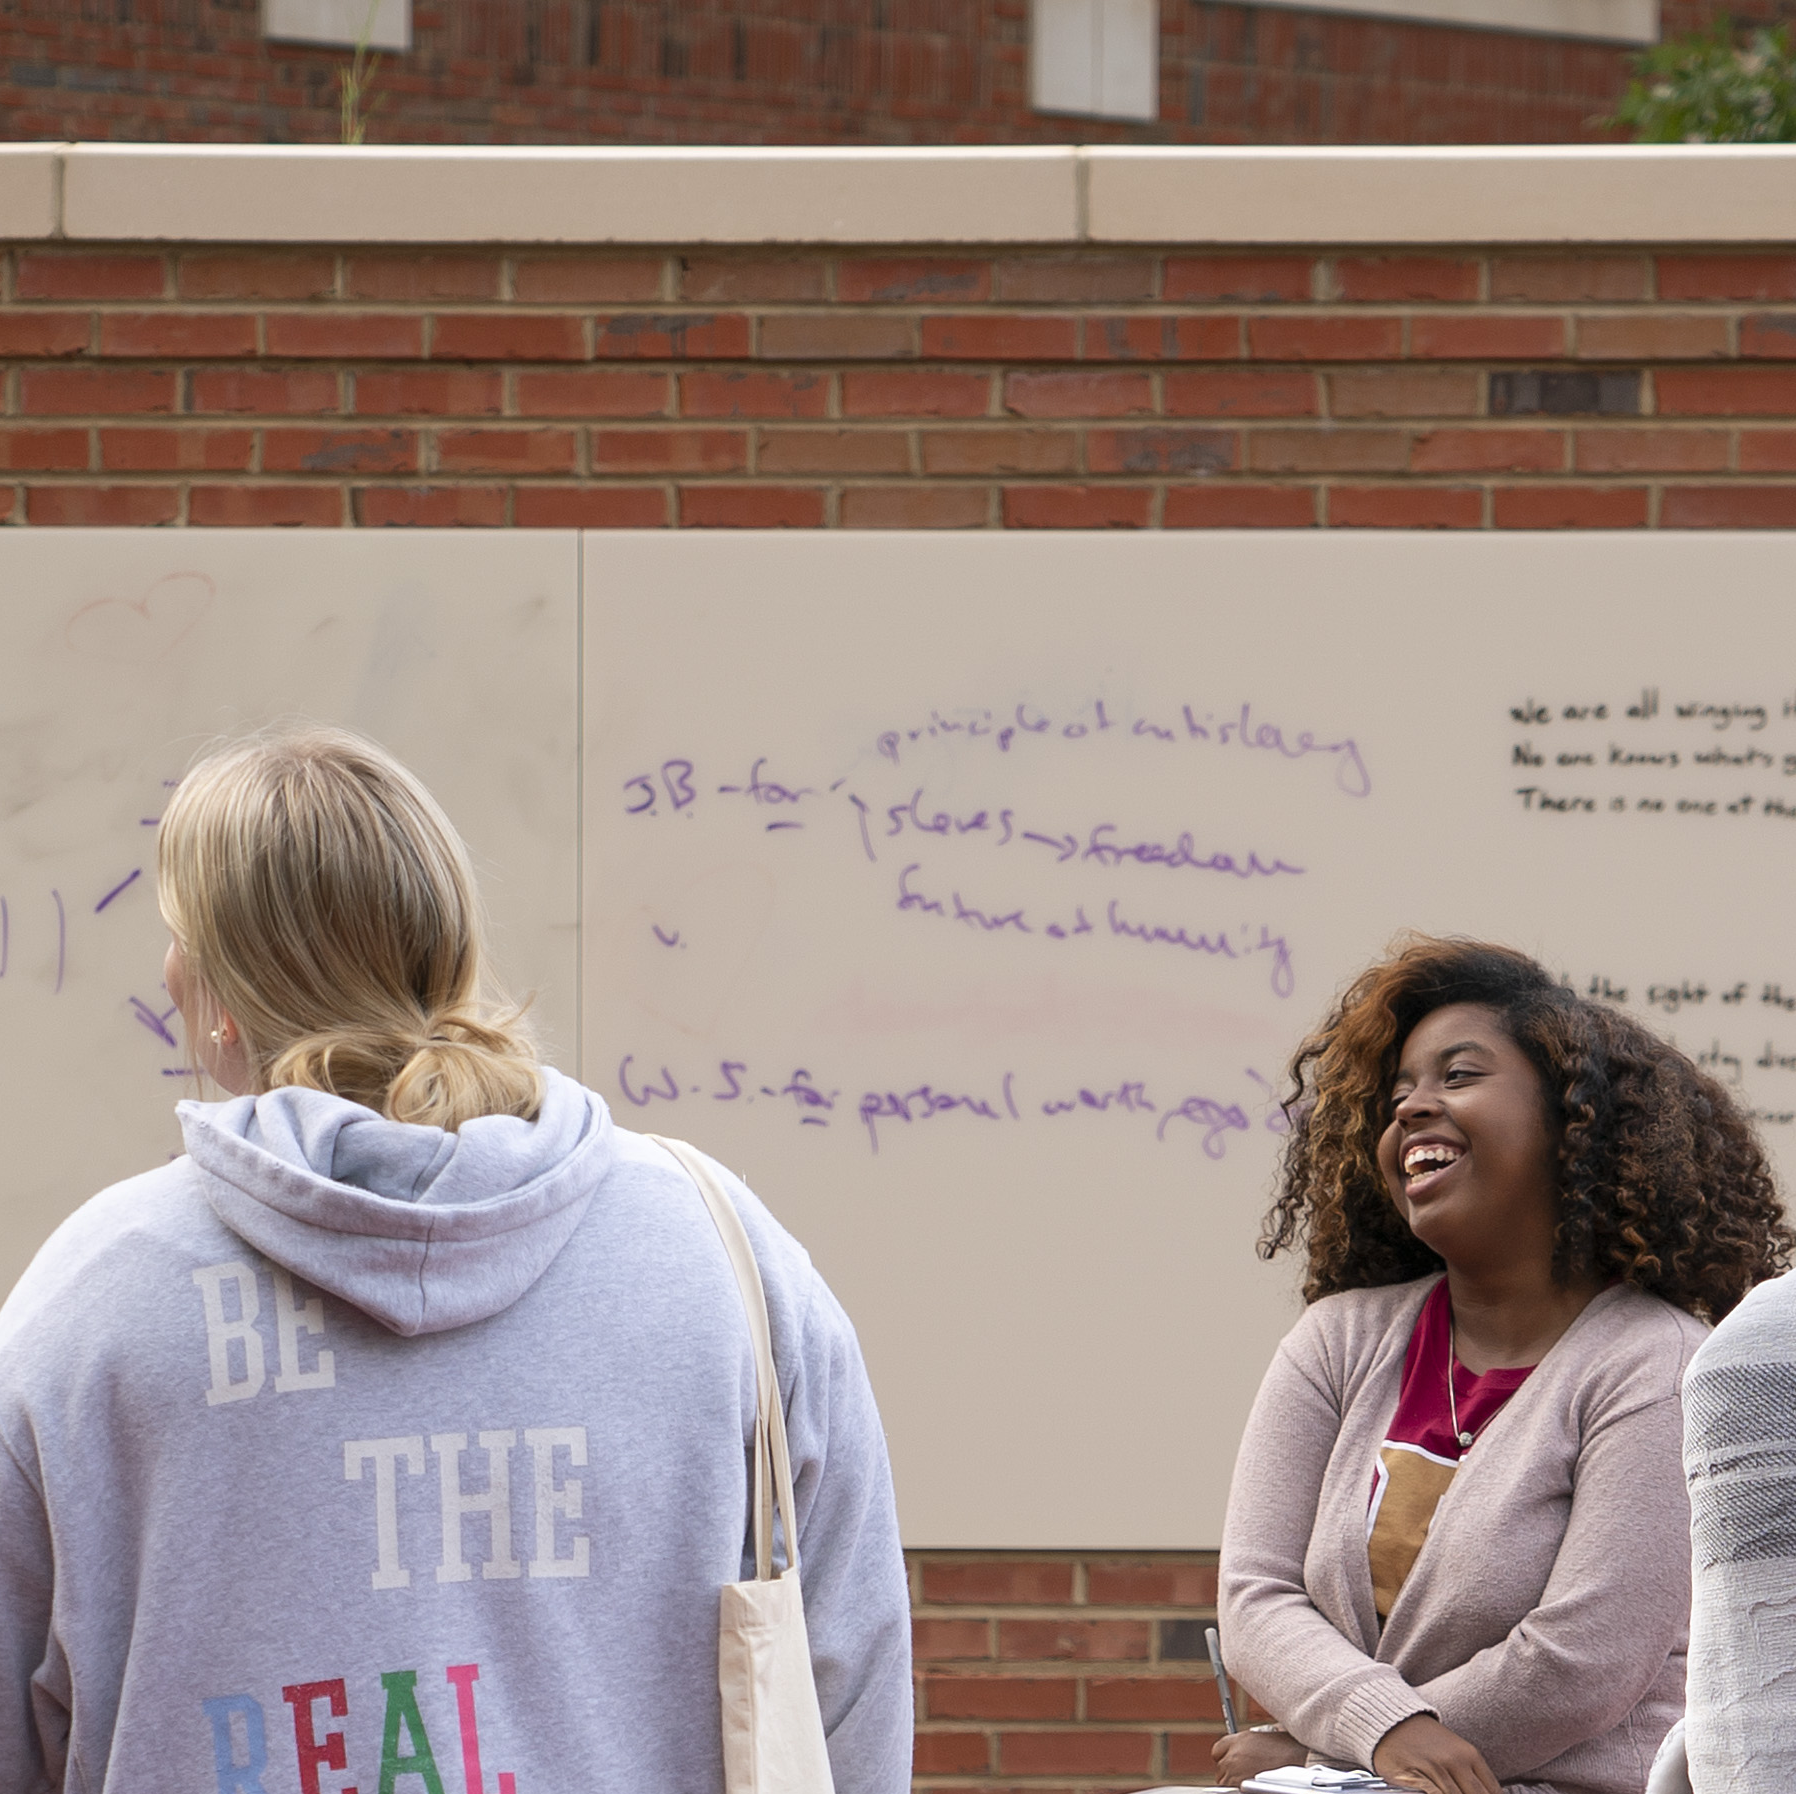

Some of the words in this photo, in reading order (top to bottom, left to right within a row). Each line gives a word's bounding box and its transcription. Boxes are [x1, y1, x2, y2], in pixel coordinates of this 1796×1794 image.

[1626, 685, 1659, 720] all
[1516, 786, 1596, 813] There
[192, 1261, 336, 1407] BE
[343, 1426, 591, 1591] THE
